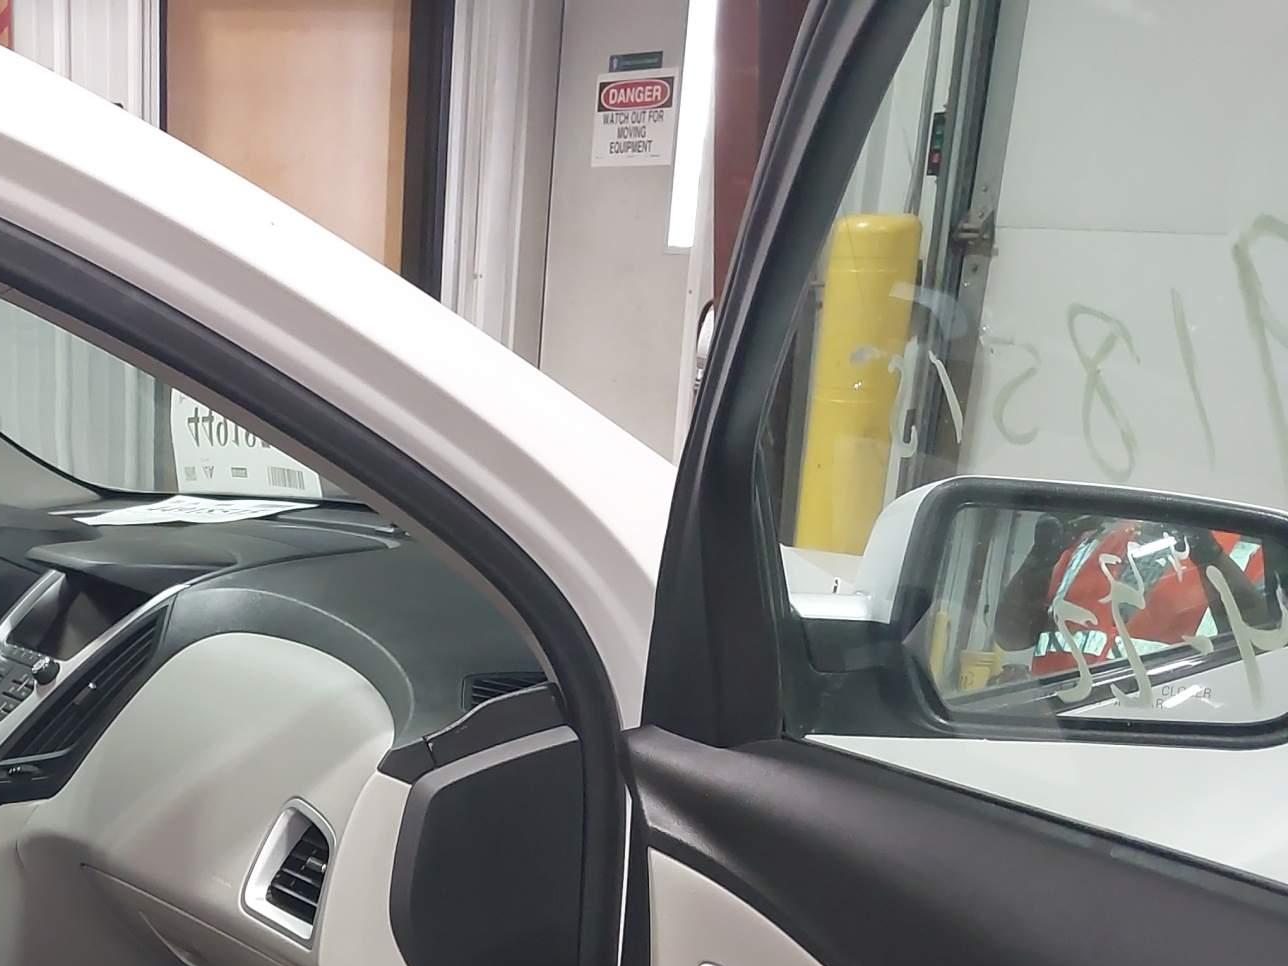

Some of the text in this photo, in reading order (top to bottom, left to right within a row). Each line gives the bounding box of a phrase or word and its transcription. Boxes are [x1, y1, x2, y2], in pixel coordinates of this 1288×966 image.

[608, 85, 662, 104] DANGER
[602, 110, 665, 125] WATCH OUT FOR
[617, 126, 647, 139] MOVING
[609, 140, 653, 154] EQUIPMENT
